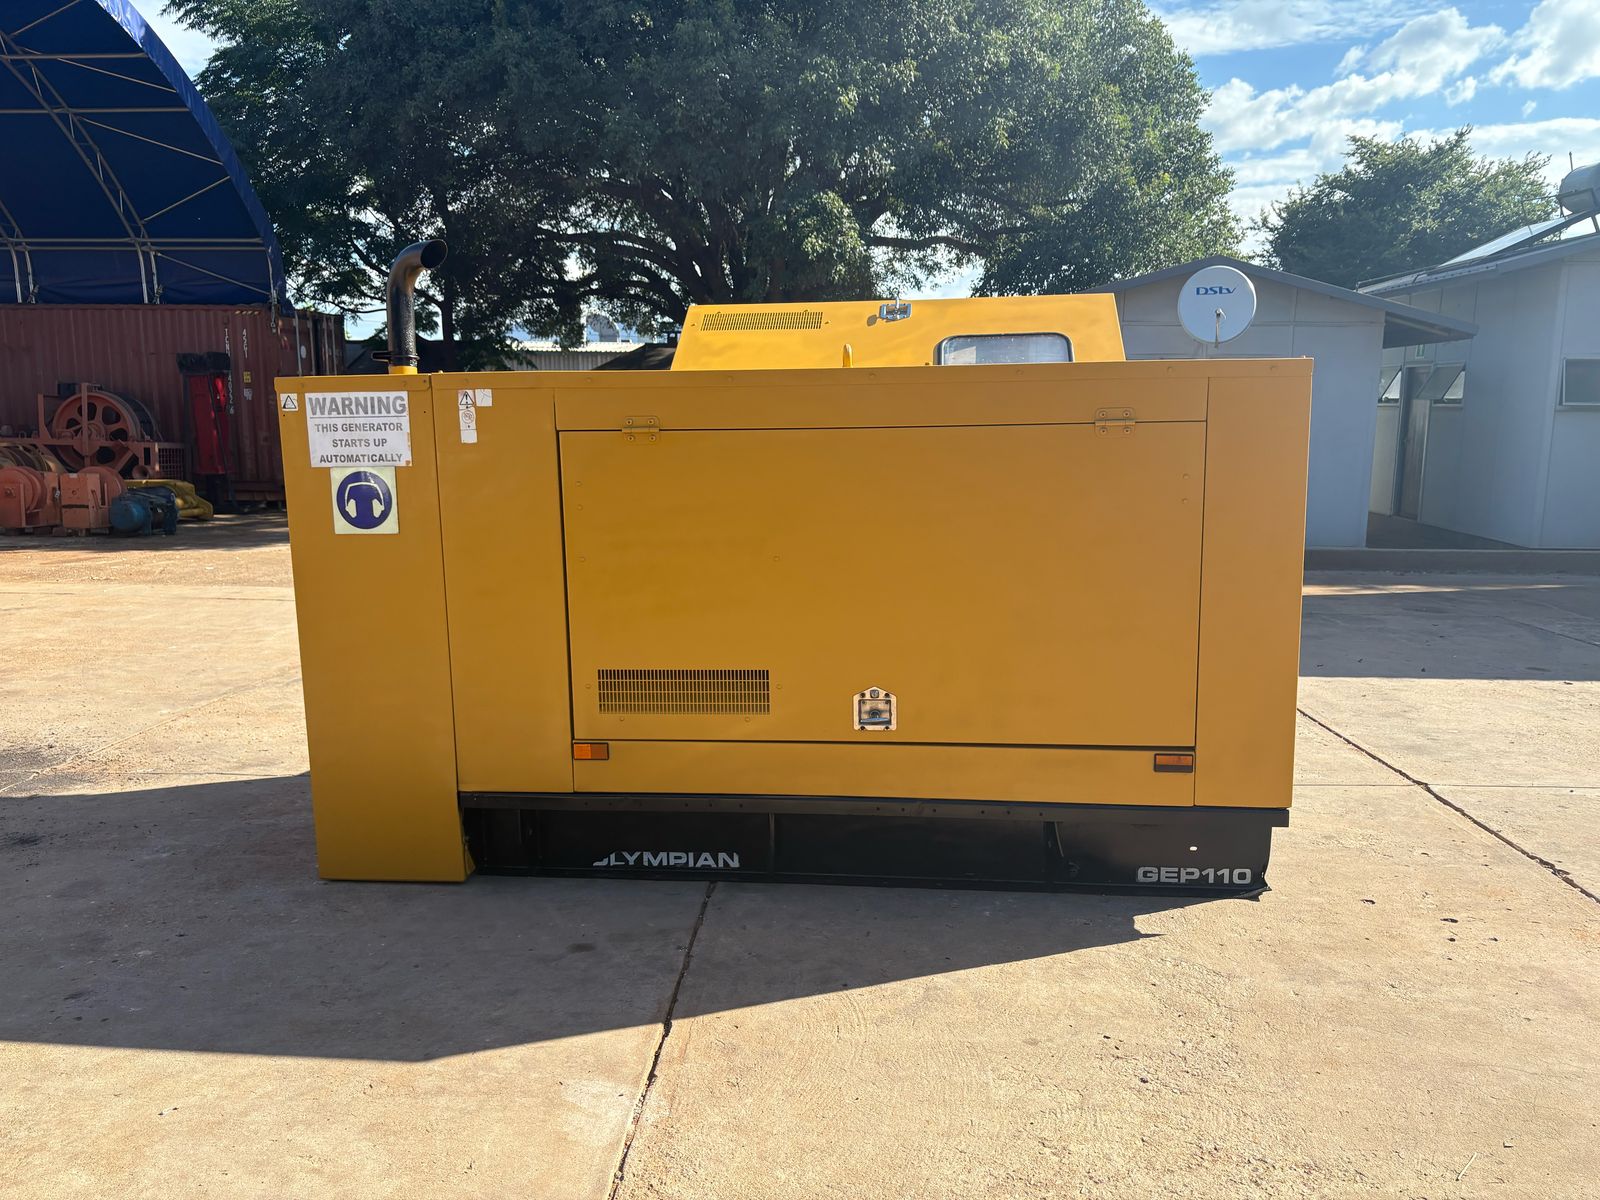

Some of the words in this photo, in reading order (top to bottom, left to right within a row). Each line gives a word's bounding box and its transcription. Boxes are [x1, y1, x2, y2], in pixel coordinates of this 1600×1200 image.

[1196, 286, 1236, 295] DStv
[308, 395, 407, 417] WARNING
[314, 423, 338, 433] THIS
[341, 422, 403, 432] GENERATOR
[332, 438, 370, 448] STARTS
[373, 438, 388, 447] UP
[319, 453, 403, 464] AUTOMATICALLY
[1137, 866, 1252, 884] GEP110
